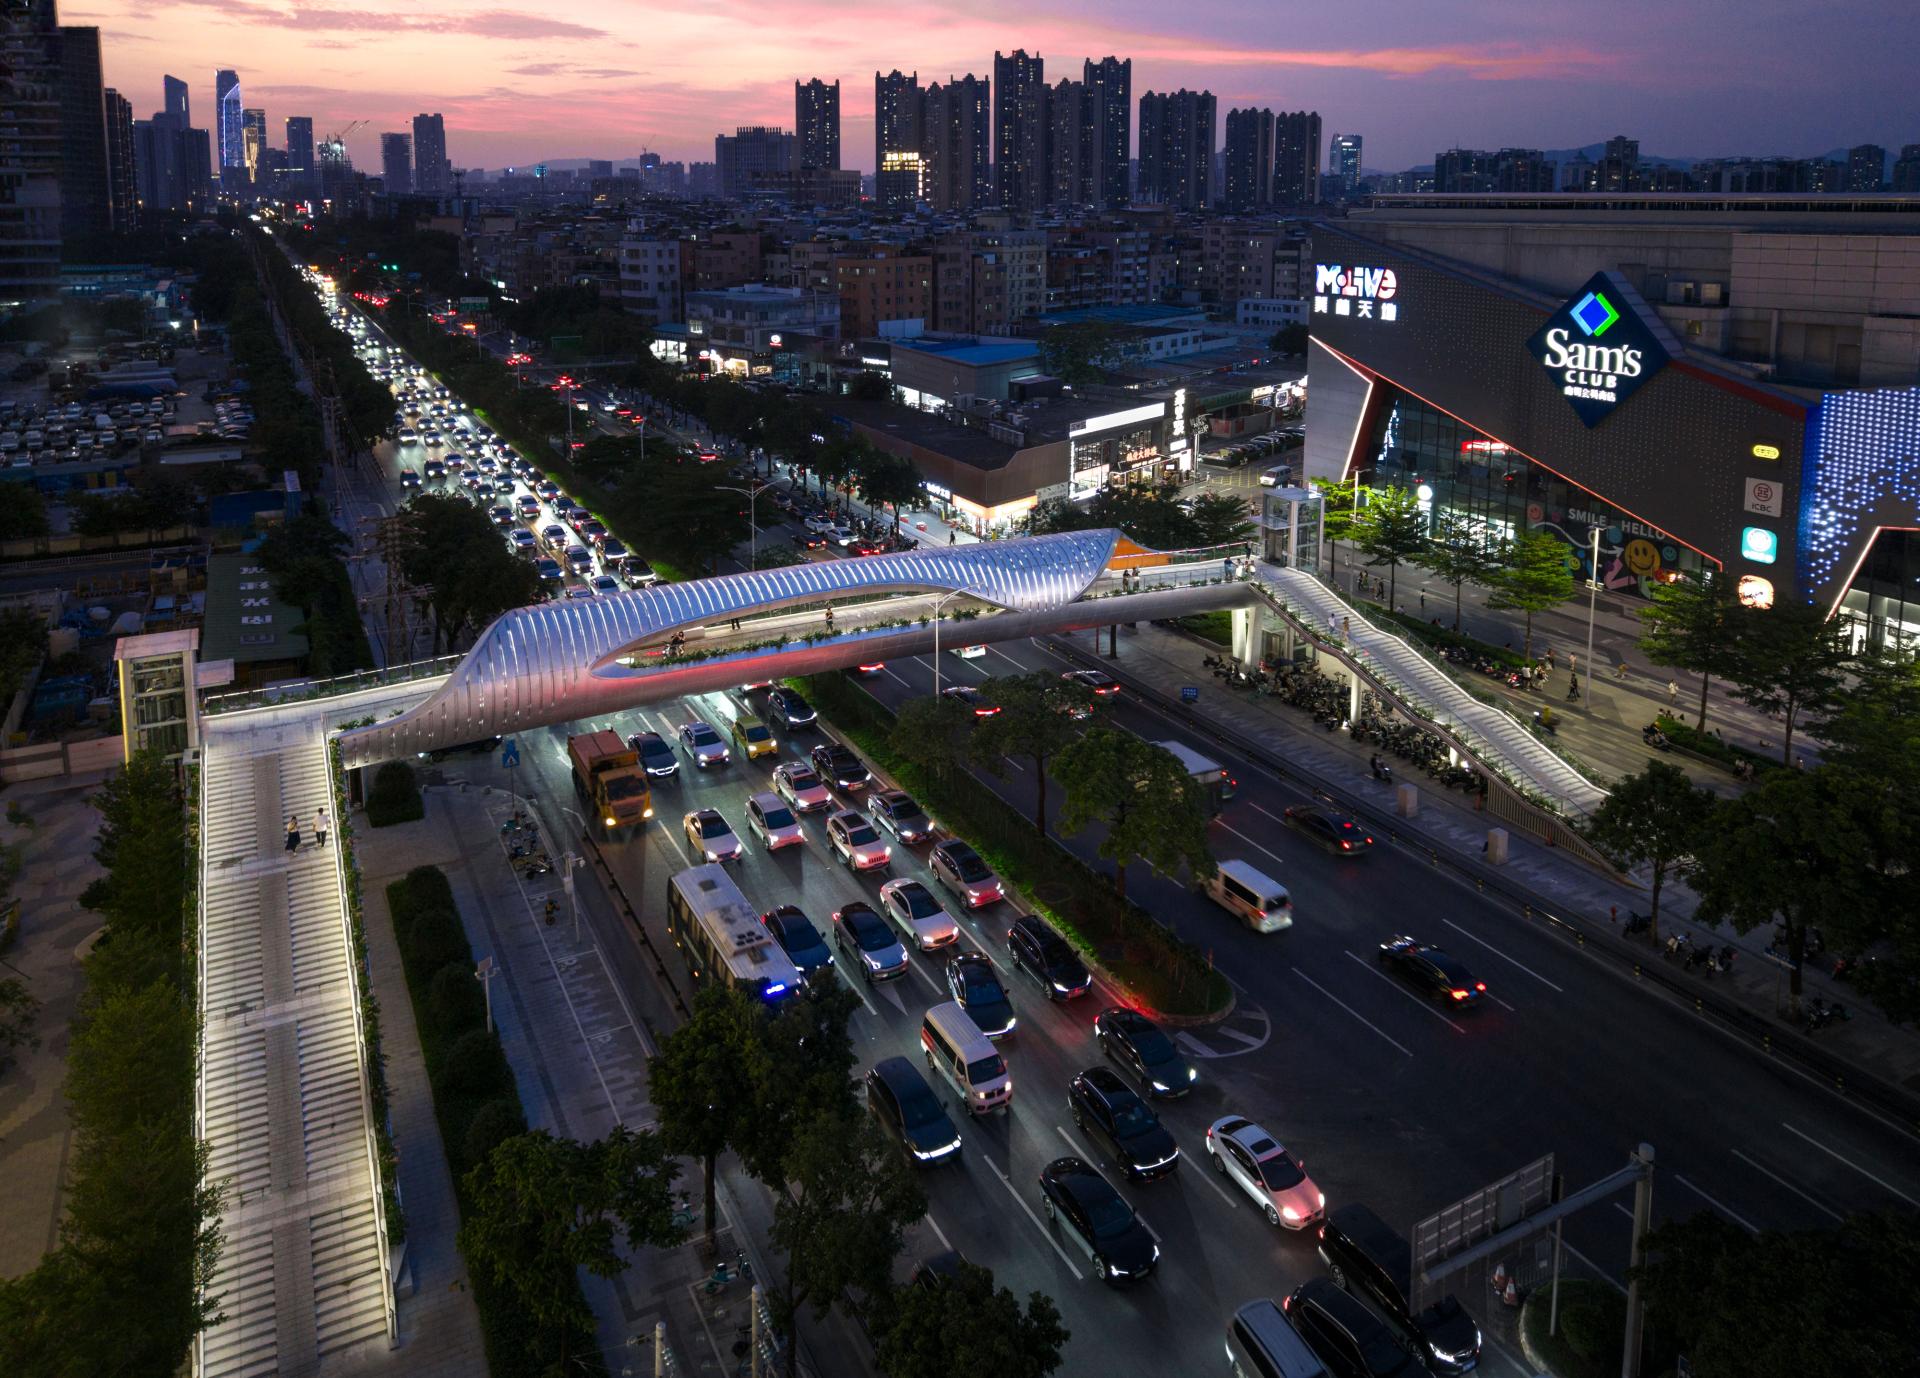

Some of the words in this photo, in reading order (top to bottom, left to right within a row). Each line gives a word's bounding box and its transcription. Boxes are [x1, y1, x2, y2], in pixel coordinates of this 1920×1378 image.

[1544, 328, 1642, 377] Sam's
[1565, 370, 1617, 388] CLUB
[1567, 508, 1607, 526] SMILE
[1751, 503, 1773, 513] ICBC
[1621, 520, 1666, 540] HELLO
